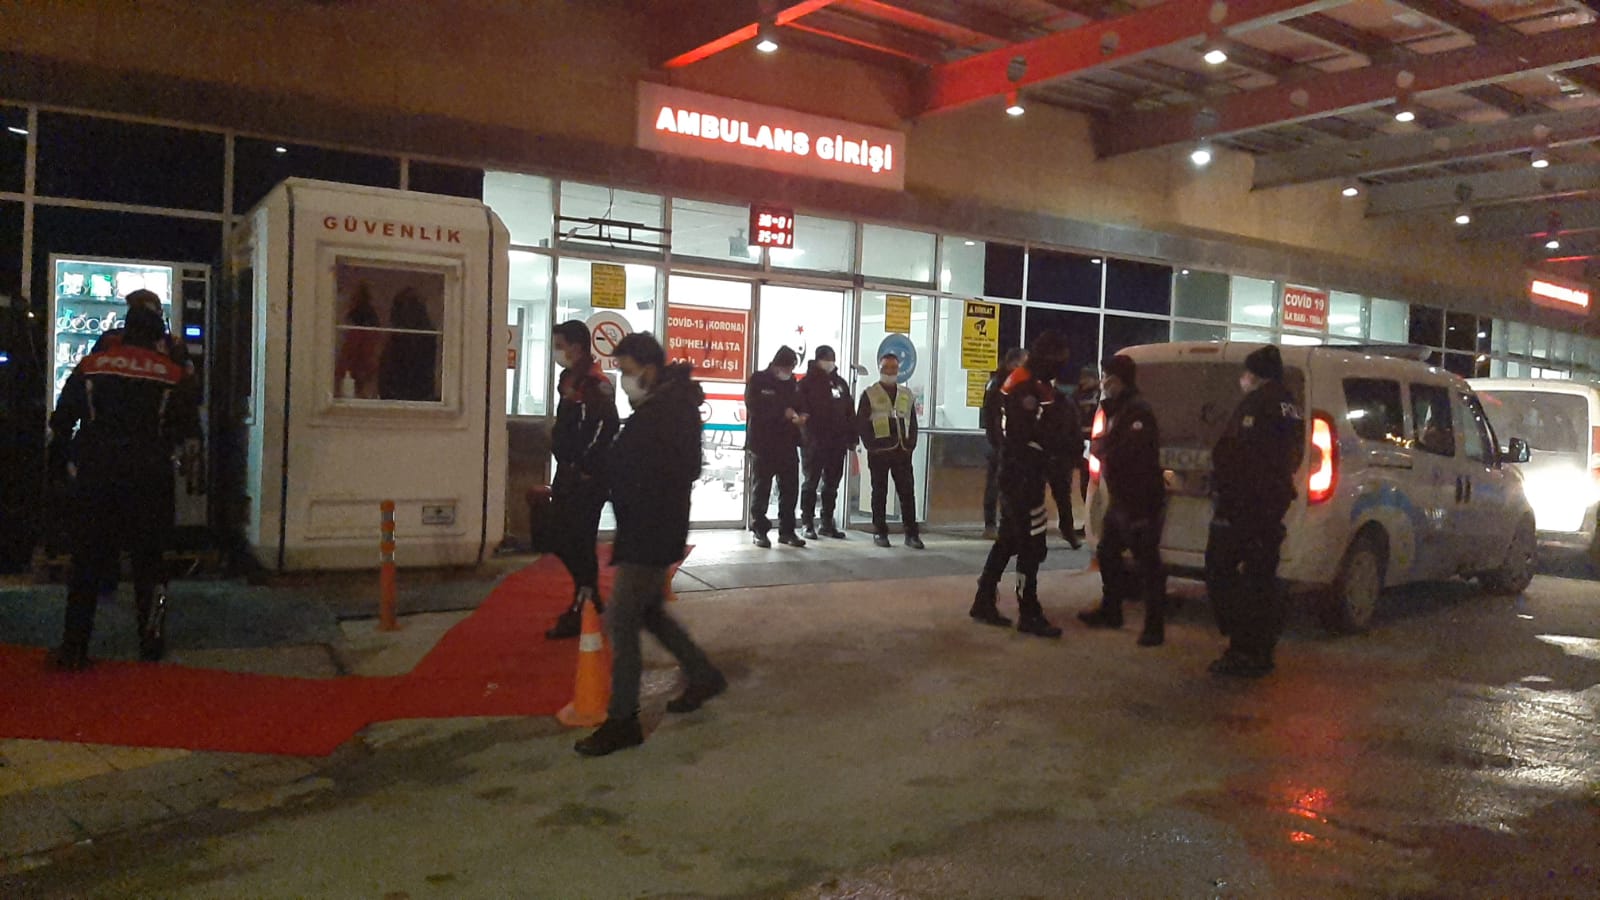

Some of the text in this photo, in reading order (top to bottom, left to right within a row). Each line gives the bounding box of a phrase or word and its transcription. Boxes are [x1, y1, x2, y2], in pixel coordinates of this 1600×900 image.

[656, 106, 892, 173] AMBULANS GİRİŞİ
[323, 215, 461, 243] GÜVENLİK
[1314, 298, 1325, 311] 19
[705, 320, 744, 335] (KORONA)
[711, 341, 741, 352] HASTA
